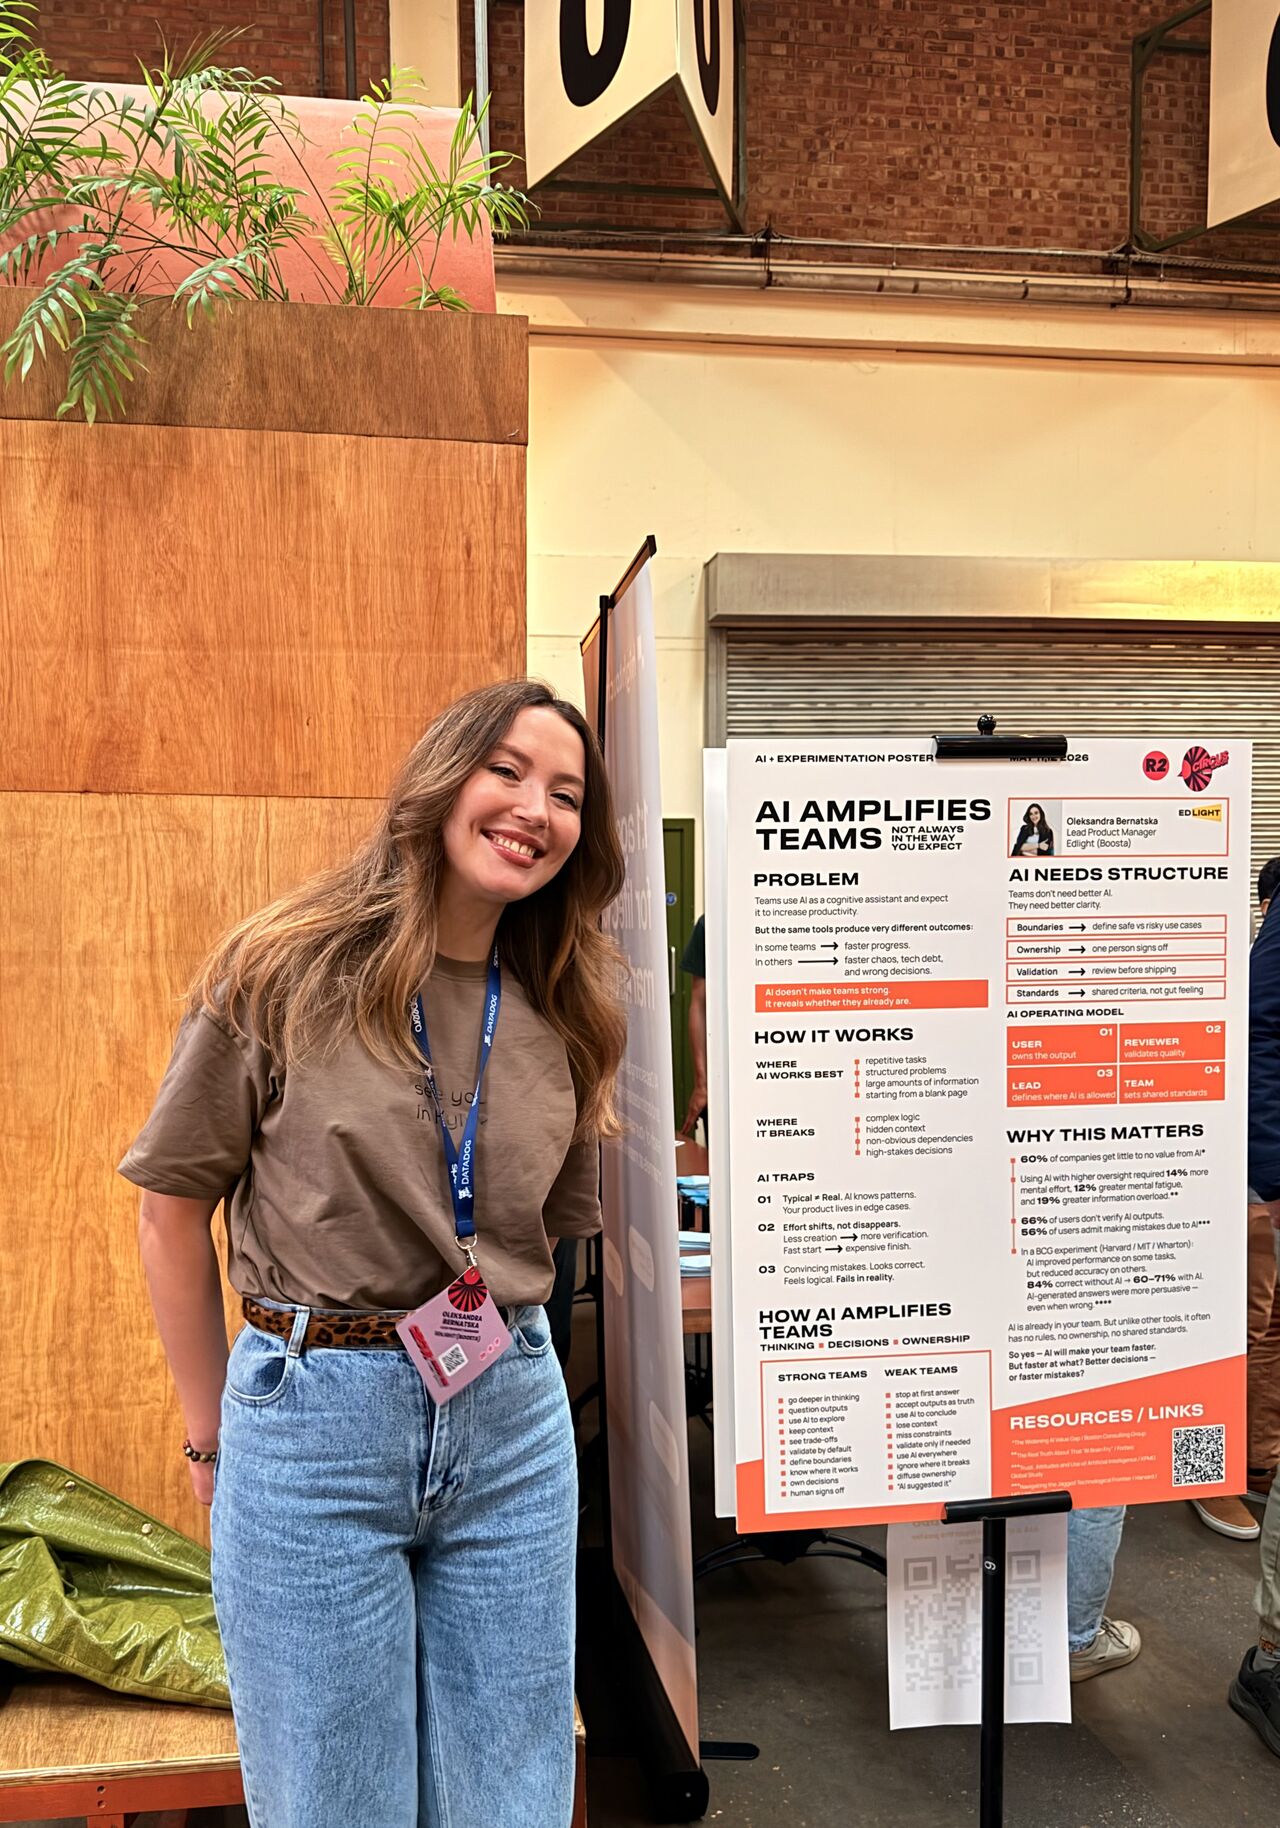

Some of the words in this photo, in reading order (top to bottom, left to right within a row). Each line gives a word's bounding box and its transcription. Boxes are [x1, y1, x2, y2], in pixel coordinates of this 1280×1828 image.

[777, 755, 885, 763] EXPERIMENTATION
[888, 754, 934, 762] POSTER
[1147, 759, 1167, 772] R2
[755, 801, 790, 823] AI
[800, 799, 991, 822] AMPLIFIES
[1066, 817, 1115, 826] Oleksandra
[1116, 817, 1159, 825] Bernatska
[918, 826, 964, 834] ALWAYS
[1066, 829, 1087, 837] Lead
[1088, 828, 1120, 837] Product
[1121, 828, 1157, 838] Manager
[756, 828, 882, 850] TEAMS
[1066, 839, 1095, 849] Edlight
[1097, 838, 1132, 848] (Boosta)
[918, 843, 963, 851] EXPECT
[1009, 869, 1029, 882] AI
[1035, 868, 1103, 881] NEEDS
[1108, 867, 1228, 880] STRUCTURE
[754, 873, 859, 887] PROBLEM
[755, 897, 782, 905] Teams
[826, 896, 864, 906] cognitive
[920, 895, 949, 904] expect
[755, 926, 770, 935] But
[812, 925, 834, 934] tools
[835, 925, 870, 935] produce
[871, 926, 890, 934] very
[1092, 922, 1117, 931] define
[1118, 922, 1135, 930] safe
[1146, 922, 1164, 931] risky
[844, 942, 870, 950] faster
[871, 942, 910, 952] progress.
[1118, 966, 1143, 974] before
[1144, 966, 1177, 975] shipping
[775, 988, 808, 996] doesn't
[860, 987, 890, 996] strong.
[487, 994, 498, 1034] DATADOG
[1020, 1009, 1084, 1018] OPERATING
[1099, 1028, 1113, 1036] 01
[1206, 1025, 1221, 1034] 02
[755, 1030, 806, 1044] HOW
[812, 1030, 830, 1043] IT
[835, 1028, 914, 1042] WORKS
[1012, 1040, 1042, 1049] USER
[1124, 1038, 1180, 1046] REVIEWER
[756, 1061, 797, 1069] WHERE
[866, 1057, 904, 1066] repetitive
[769, 1071, 812, 1080] WORKS
[814, 1070, 844, 1078] BEST
[866, 1068, 908, 1076] structured
[910, 1067, 947, 1077] problems
[1097, 1069, 1113, 1078] 03
[1205, 1066, 1221, 1074] 04
[1012, 1082, 1041, 1090] LEAD
[417, 1105, 430, 1121] in
[756, 1118, 798, 1126] WHERE
[770, 1129, 815, 1137] BREAKS
[1006, 1130, 1055, 1143] WHY
[1060, 1128, 1106, 1141] THIS
[1111, 1124, 1204, 1140] MATTERS
[462, 1140, 472, 1184] DATADOG
[1020, 1155, 1048, 1163] 60%
[1050, 1154, 1059, 1163] of
[1059, 1154, 1102, 1163] companies
[1102, 1153, 1116, 1163] get
[757, 1174, 769, 1183] AI
[772, 1173, 815, 1182] TRAPS
[758, 1196, 771, 1204] 01
[758, 1223, 775, 1232] 02
[783, 1224, 807, 1232] Effort
[808, 1222, 835, 1231] shifts,
[852, 1222, 901, 1230] disappears.
[759, 1265, 776, 1274] 03
[442, 1311, 482, 1322] OLEKSANDRA
[759, 1309, 811, 1324] HOW
[815, 1308, 836, 1321] AI
[841, 1303, 952, 1320] AMPLIFIES
[442, 1319, 479, 1329] BERNATSKA
[759, 1324, 833, 1339] TEAMS
[828, 1339, 889, 1349] DECISIONS
[902, 1335, 970, 1345] OWNERSHIP
[760, 1342, 815, 1351] THINKING
[1009, 1351, 1020, 1359] So
[1020, 1352, 1035, 1360] yes
[1091, 1347, 1109, 1356] your
[778, 1372, 826, 1382] STRONG
[828, 1370, 868, 1379] TEAMS
[884, 1368, 917, 1377] WEAK
[919, 1366, 958, 1375] TEAMS
[1044, 1370, 1085, 1379] mistakes?
[788, 1406, 820, 1415] question
[1010, 1409, 1133, 1429] RESOURCES
[1149, 1404, 1204, 1420] LINKS
[803, 1436, 838, 1444] trade-offs
